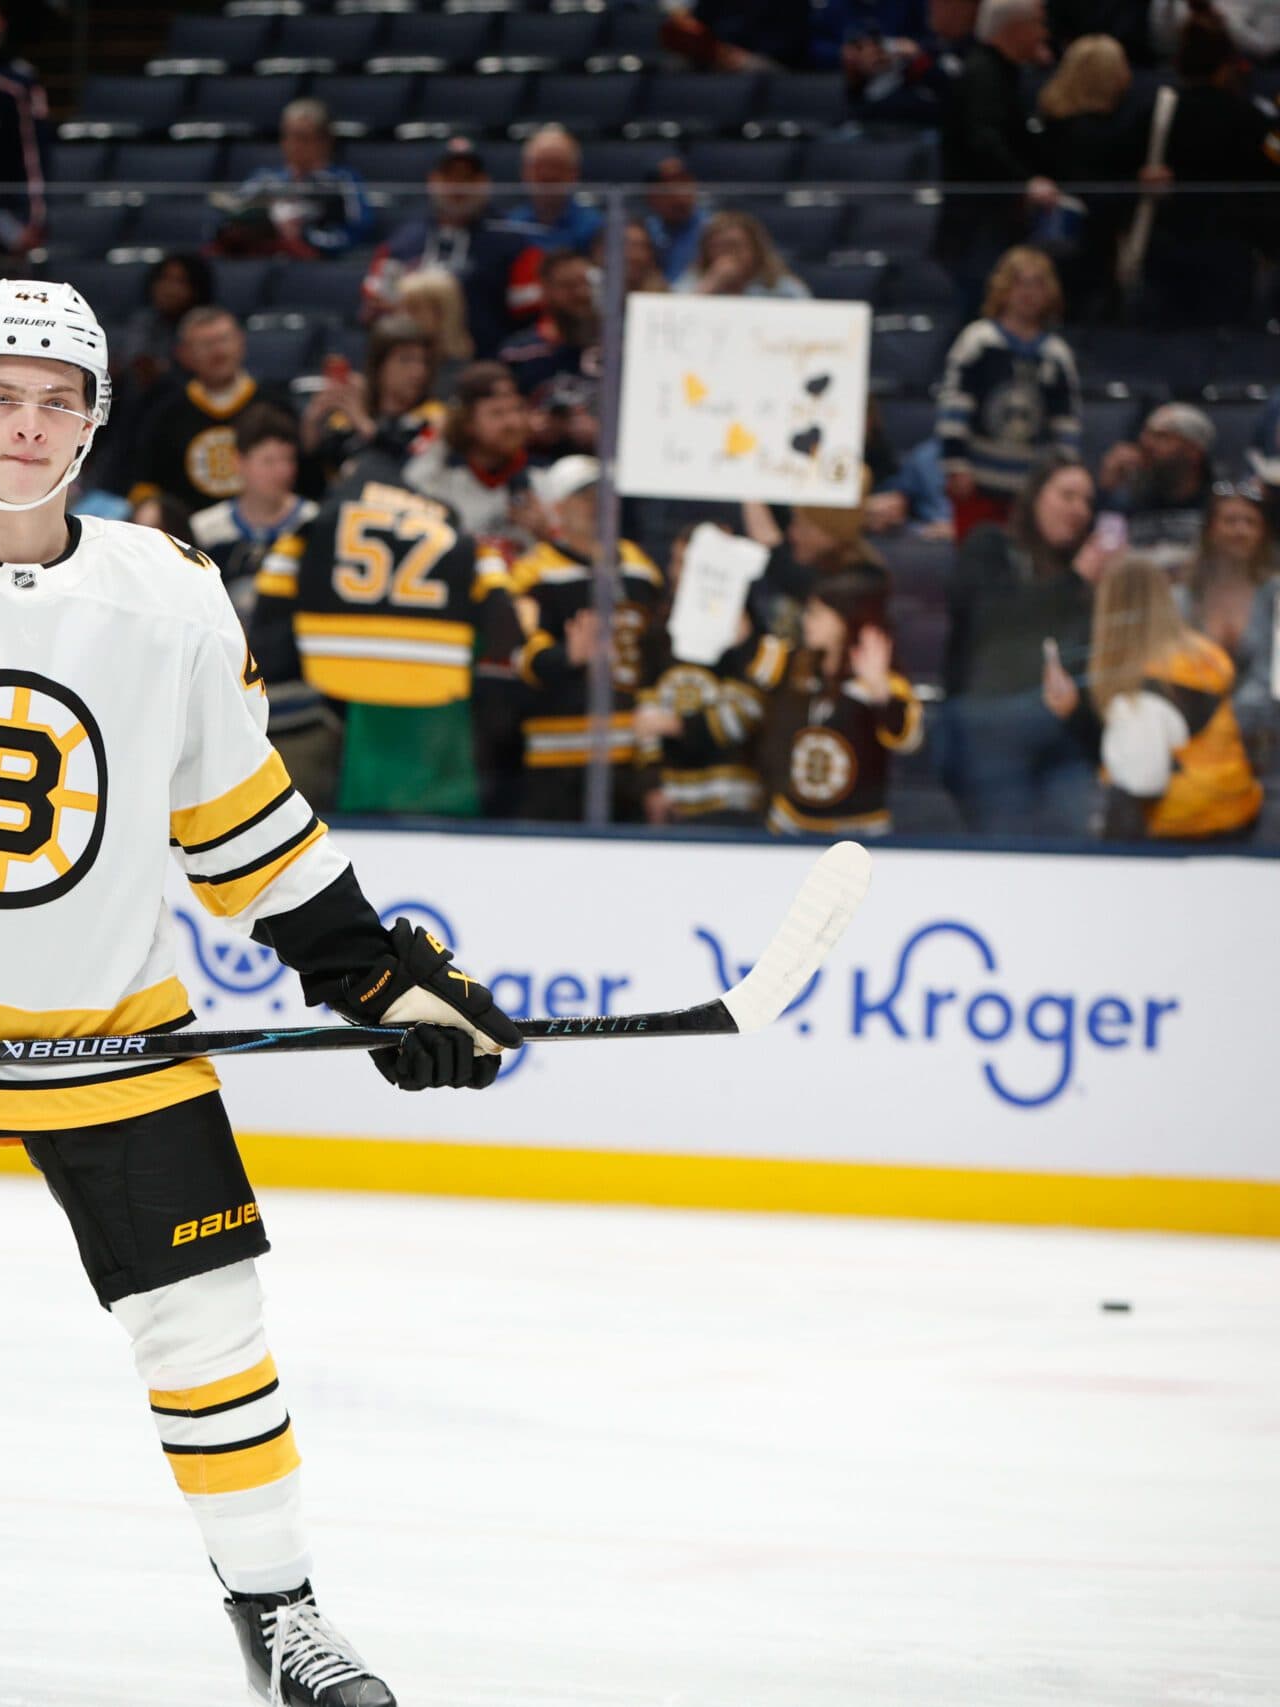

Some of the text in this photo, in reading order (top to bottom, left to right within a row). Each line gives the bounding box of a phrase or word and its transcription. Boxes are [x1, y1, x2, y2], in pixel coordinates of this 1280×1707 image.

[3, 317, 57, 328] BAUER
[331, 502, 457, 609] 52
[360, 969, 392, 1003] BAUER
[547, 1020, 649, 1034] FLYLITE
[851, 920, 1180, 1107] Kroger
[28, 1037, 146, 1058] BAUER
[172, 1202, 260, 1247] BAUE
